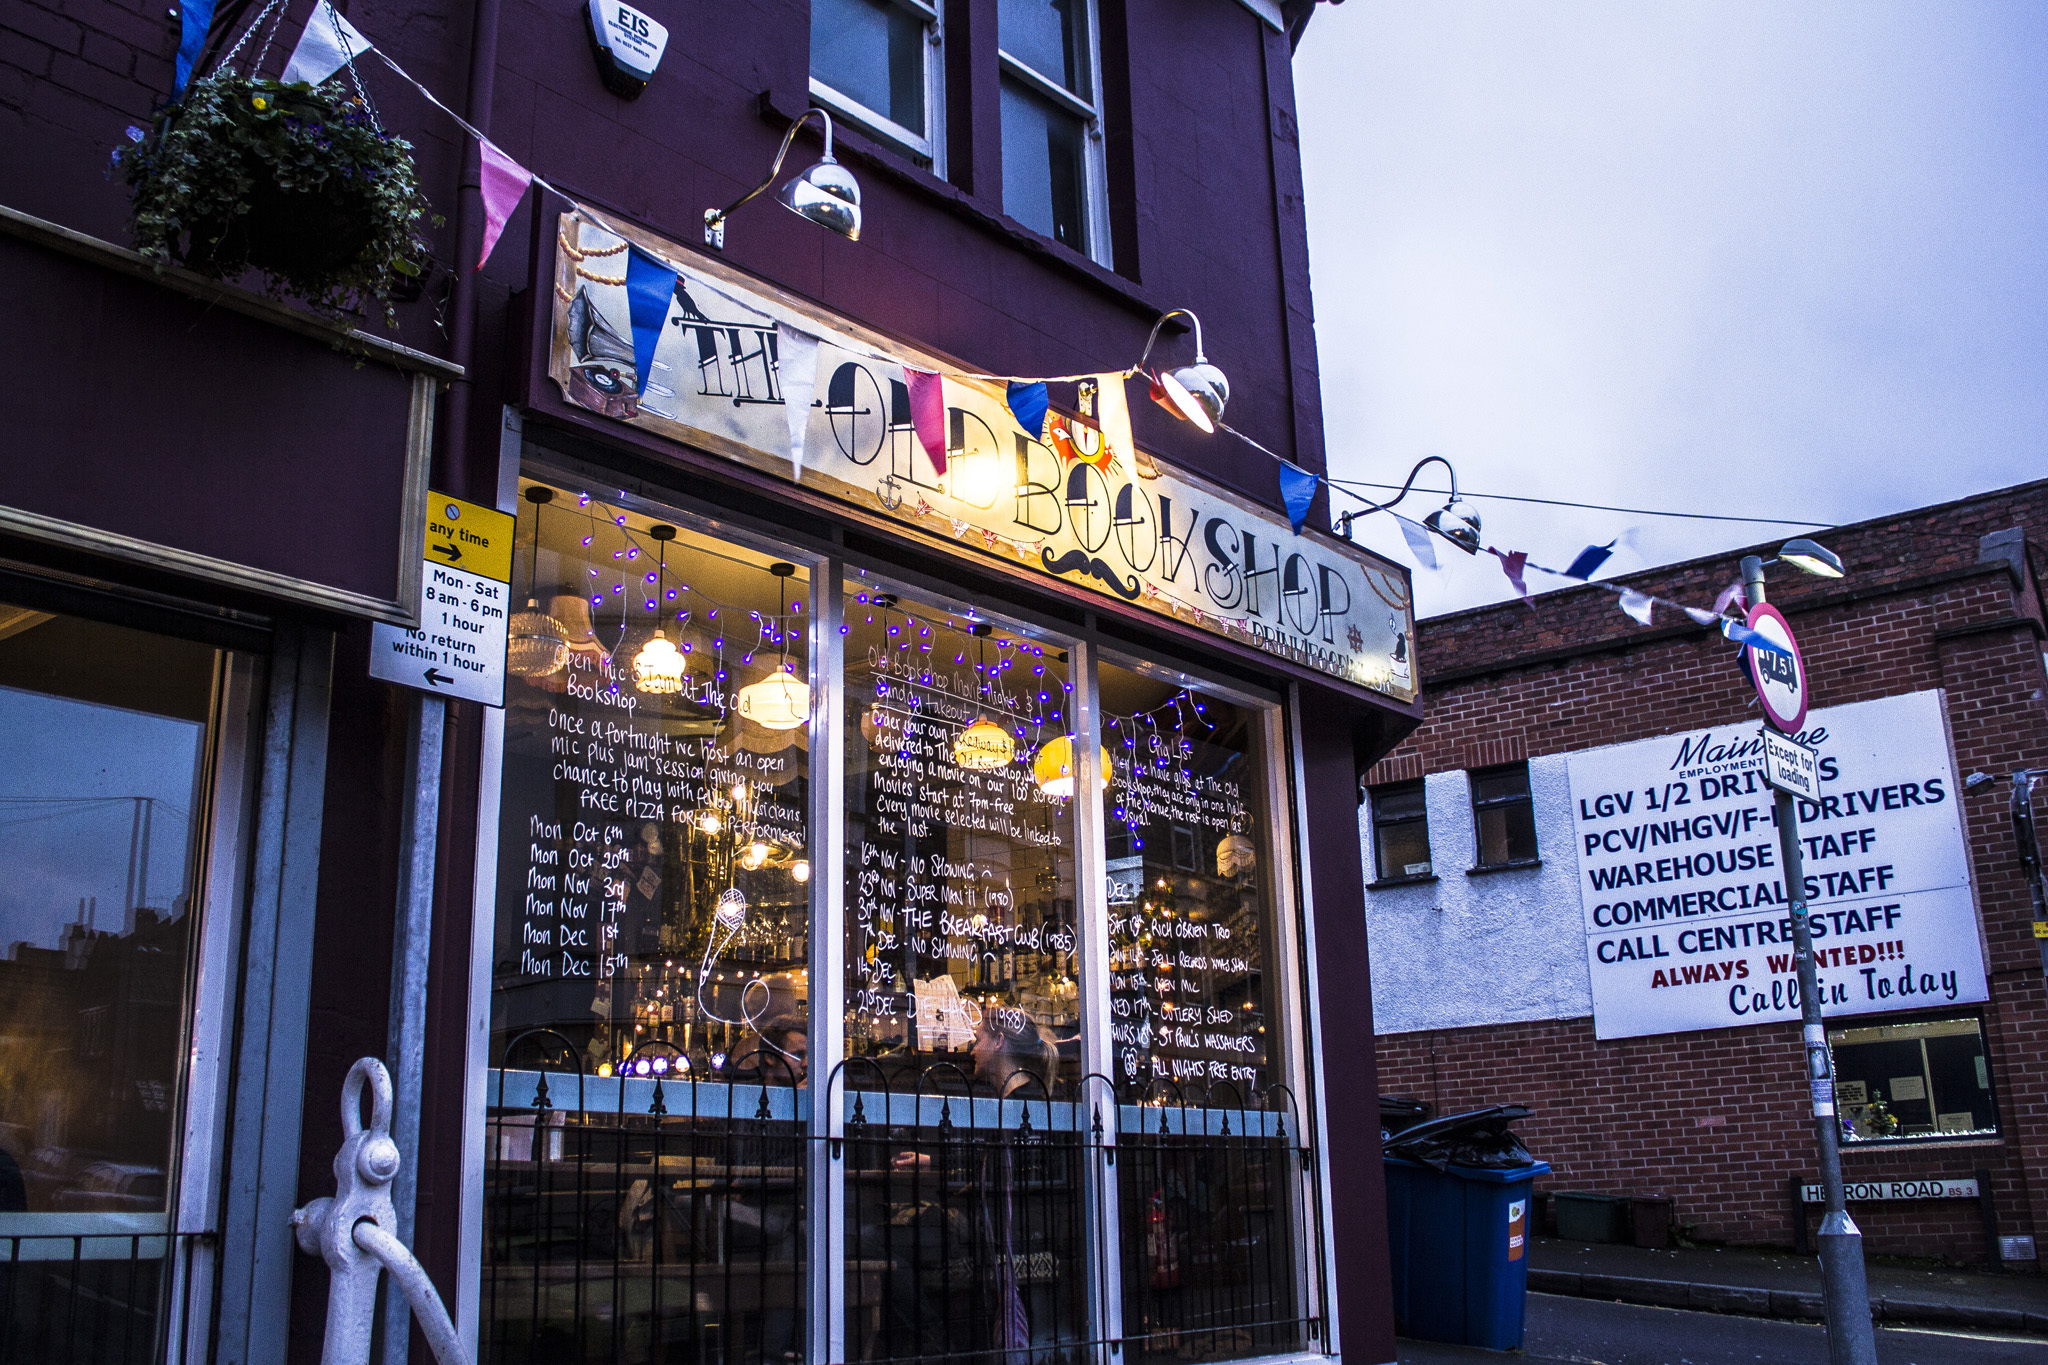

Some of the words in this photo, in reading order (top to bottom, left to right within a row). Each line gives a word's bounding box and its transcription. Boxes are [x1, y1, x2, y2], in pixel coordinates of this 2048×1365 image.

[619, 7, 649, 38] EIS
[429, 521, 455, 541] any
[459, 527, 490, 548] time
[1013, 431, 1350, 644] BOOKSHOP
[433, 569, 463, 590] Mon
[475, 581, 499, 599] Sat
[426, 587, 435, 600] 8
[438, 593, 459, 607] am
[470, 599, 479, 612] 6
[482, 605, 503, 619] pm
[441, 612, 447, 625] 1
[453, 615, 485, 634] hour
[405, 628, 426, 641] No
[431, 634, 476, 654] return
[392, 641, 437, 661] within
[442, 651, 448, 664] 1
[453, 654, 485, 673] hour
[553, 644, 592, 672] Open
[681, 681, 698, 700] at
[702, 682, 727, 709] The
[926, 693, 971, 722] takeout
[549, 708, 585, 737] Once
[591, 720, 603, 739] a
[604, 722, 672, 760] fortnight
[675, 740, 696, 757] we
[701, 737, 730, 761] host
[735, 752, 753, 768] an
[757, 756, 784, 777] open
[875, 728, 922, 755] delivered
[923, 741, 934, 757] to
[935, 742, 956, 764] The
[928, 725, 948, 744] own
[551, 736, 580, 755] mic
[587, 740, 615, 765] plus
[620, 750, 649, 777] jam
[656, 759, 704, 779] session
[709, 768, 746, 791] giving
[752, 775, 774, 800] you
[1679, 758, 1764, 779] EMPLOYMENT
[1767, 739, 1799, 767] Except
[1801, 753, 1813, 772] for
[553, 760, 611, 788] chance
[612, 770, 629, 793] to
[633, 777, 662, 800] play
[667, 781, 694, 801] with
[879, 753, 924, 782] enjoying
[937, 764, 966, 783] movie
[969, 775, 982, 788] on
[987, 780, 1005, 793] our
[1150, 759, 1170, 781] have
[1206, 776, 1222, 792] The
[1224, 782, 1239, 798] Old
[1778, 761, 1810, 792] loading
[580, 789, 619, 812] FREE
[625, 801, 665, 821] PIZZA
[874, 771, 913, 797] Movies
[919, 782, 949, 806] start
[952, 790, 965, 808] at
[1580, 790, 1633, 821] LGV
[1644, 782, 1691, 813] 1/2
[1800, 779, 1945, 824] DRIVERS
[530, 814, 562, 840] Mon
[573, 822, 600, 842] Oct
[604, 825, 623, 845] 6th
[877, 794, 908, 821] Every
[911, 803, 941, 821] movie
[944, 809, 986, 830] selected
[989, 817, 1009, 836] will
[1009, 819, 1023, 838] be
[1024, 819, 1051, 843] linked
[1052, 831, 1062, 847] to
[878, 815, 898, 835] the
[907, 816, 932, 838] last.
[1212, 817, 1230, 832] open
[530, 843, 559, 866] Mon
[568, 849, 595, 868] Oct
[601, 847, 630, 869] 20th
[931, 853, 975, 882] SHOWING
[1589, 844, 1775, 891] WAREHOUSE
[527, 866, 556, 891] Mon
[564, 873, 590, 895] Nov
[603, 877, 625, 900] 3rd
[1106, 876, 1130, 898] DEC
[1593, 882, 1789, 927] COMMERCIAL
[1804, 865, 1894, 901] STAFF
[525, 893, 554, 916] Mon
[560, 898, 588, 919] Nov
[600, 901, 627, 922] 17th
[985, 886, 1014, 912] (1980)
[523, 921, 551, 945] Mon
[560, 924, 589, 947] Dec
[601, 926, 620, 950] 1st
[901, 907, 933, 929] THE
[1040, 921, 1077, 960] (1985)
[1151, 918, 1173, 939] RICH
[1596, 935, 1669, 965] CALL
[1678, 918, 1792, 954] CENTRE
[1809, 904, 1901, 939] STAFF
[520, 949, 551, 976] Mon
[562, 951, 591, 976] Dec
[600, 953, 629, 979] 15th
[931, 937, 978, 964] SHOWING
[1651, 960, 1749, 988] ALWAYS
[1729, 984, 1800, 1016] Call
[1818, 977, 1849, 1005] in
[1859, 964, 1959, 1000] Today
[989, 1003, 1026, 1034] (1988)
[1206, 1006, 1234, 1025] SHED
[1891, 1181, 1943, 1198] ROAD
[1949, 1188, 1963, 1196] BS
[1966, 1187, 1973, 1195] 3
